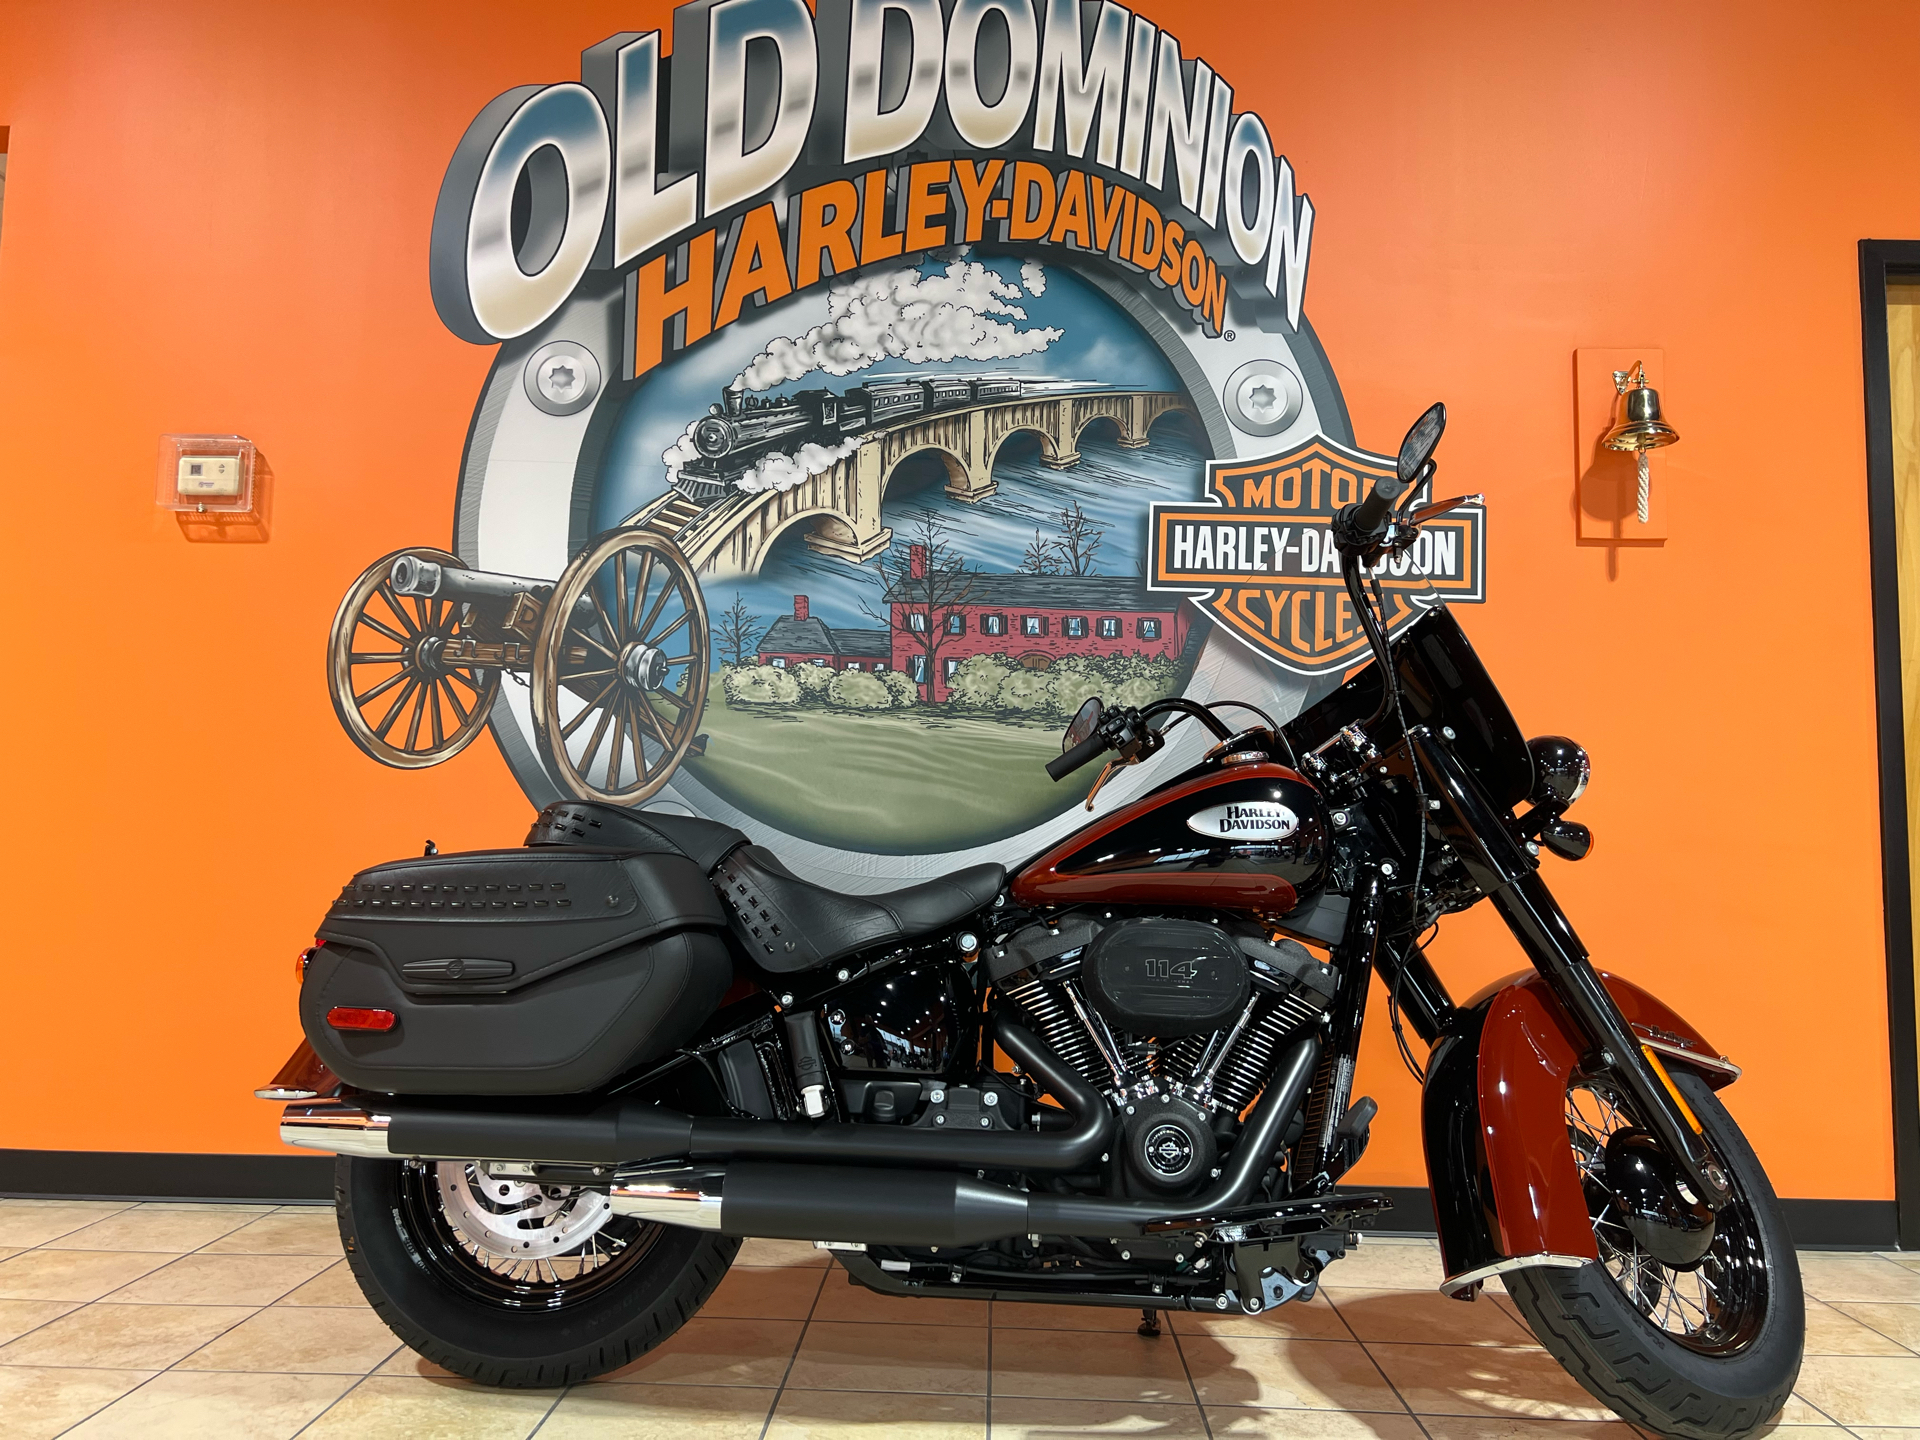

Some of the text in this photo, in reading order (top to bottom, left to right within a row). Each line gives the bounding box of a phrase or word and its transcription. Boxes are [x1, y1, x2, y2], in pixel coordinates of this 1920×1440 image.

[460, 0, 1314, 344] OLD DOMINION
[632, 158, 1228, 380] HARLEY-DAVIDSON
[1173, 524, 1457, 577] HARLEY-DAON
[1219, 818, 1291, 833] DAVIDSON
[1226, 806, 1281, 819] HARLEY
[1145, 958, 1198, 980] 114
